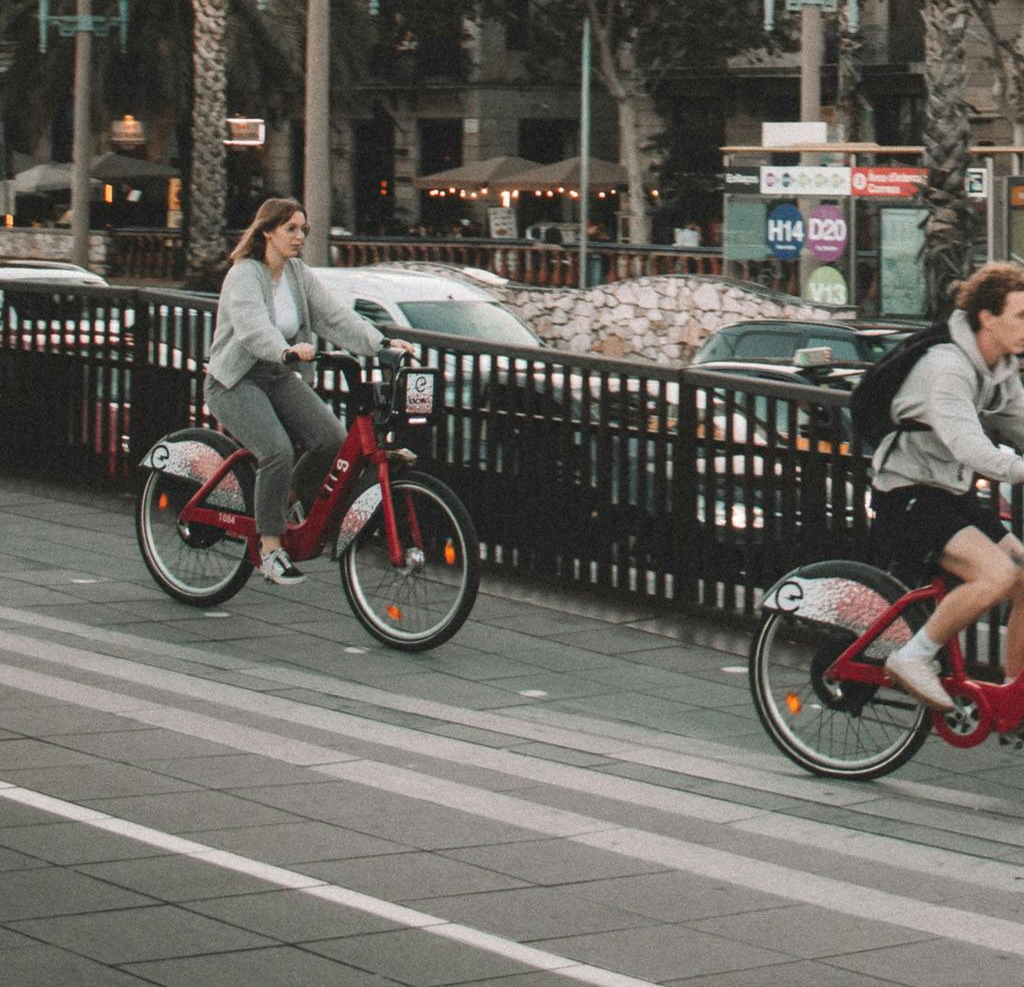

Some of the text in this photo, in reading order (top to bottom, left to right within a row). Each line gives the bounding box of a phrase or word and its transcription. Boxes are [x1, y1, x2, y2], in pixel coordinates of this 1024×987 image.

[767, 219, 804, 242] H14
[808, 218, 847, 241] D20
[808, 282, 847, 304] V13
